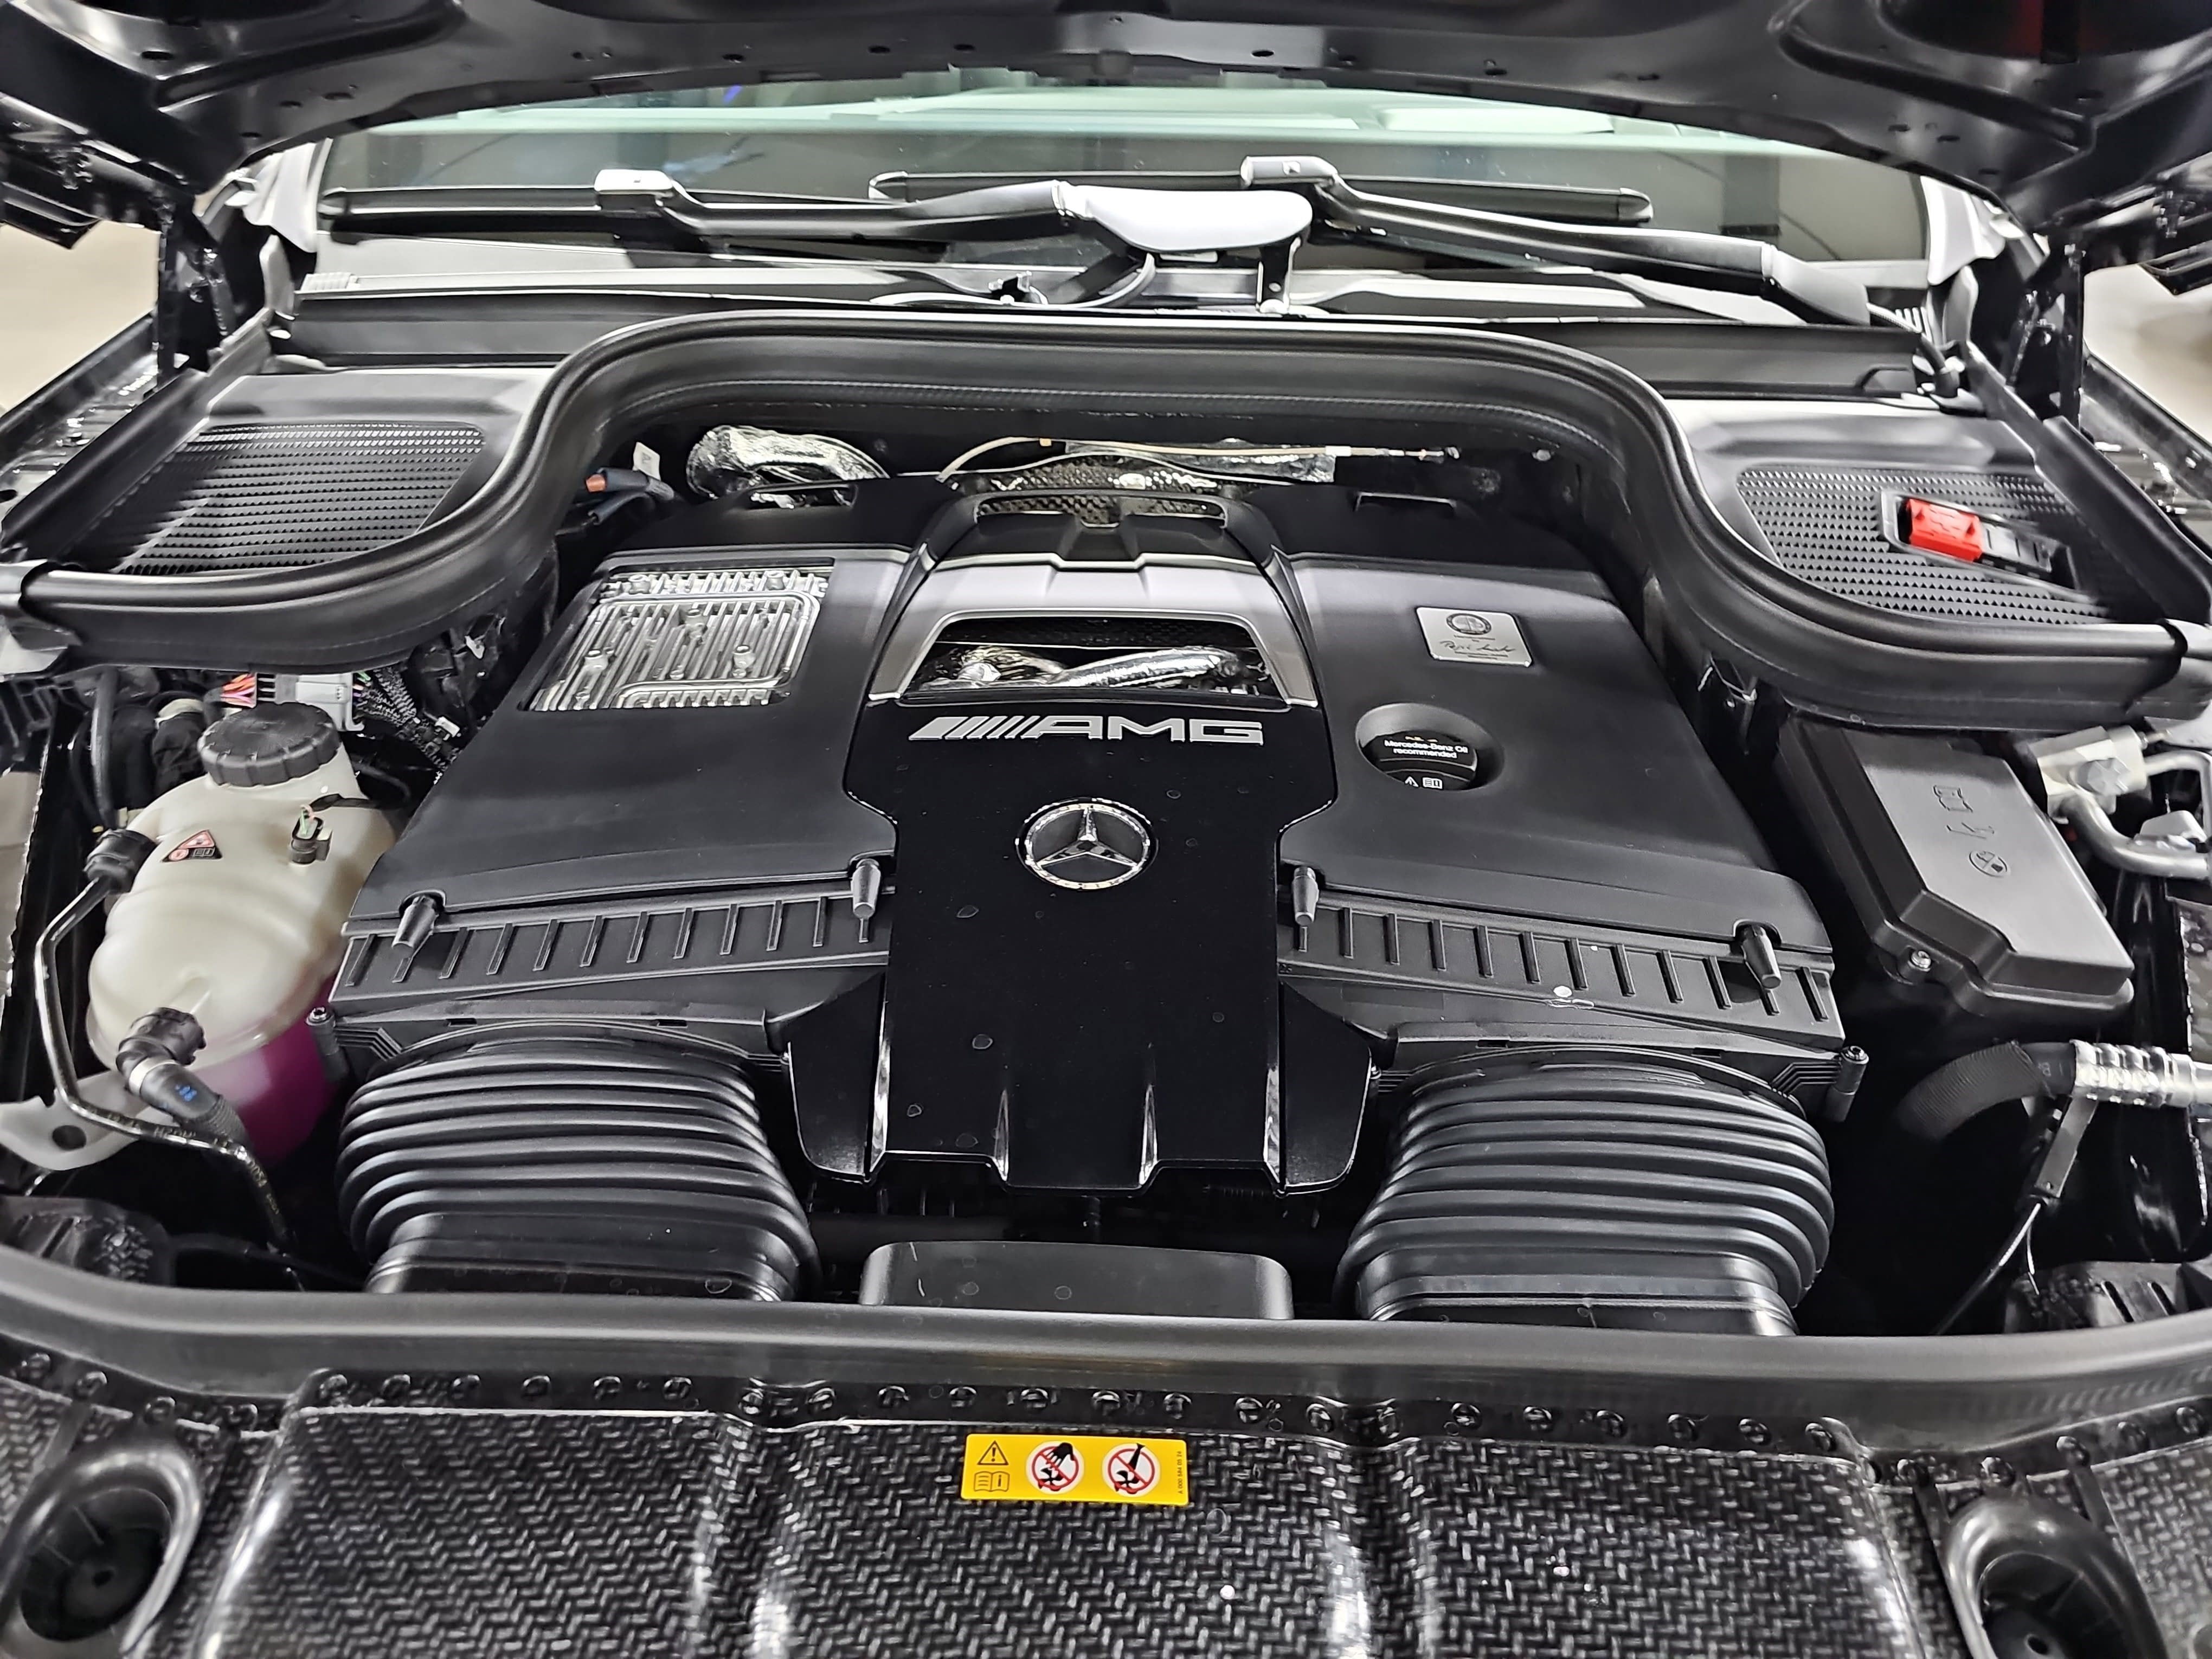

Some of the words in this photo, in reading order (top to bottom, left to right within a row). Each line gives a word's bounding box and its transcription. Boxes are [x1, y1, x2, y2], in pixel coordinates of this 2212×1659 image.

[1019, 715, 1264, 745] AMG
[1384, 740, 1454, 751] Mercedes-Benz
[1393, 748, 1457, 758] recommended
